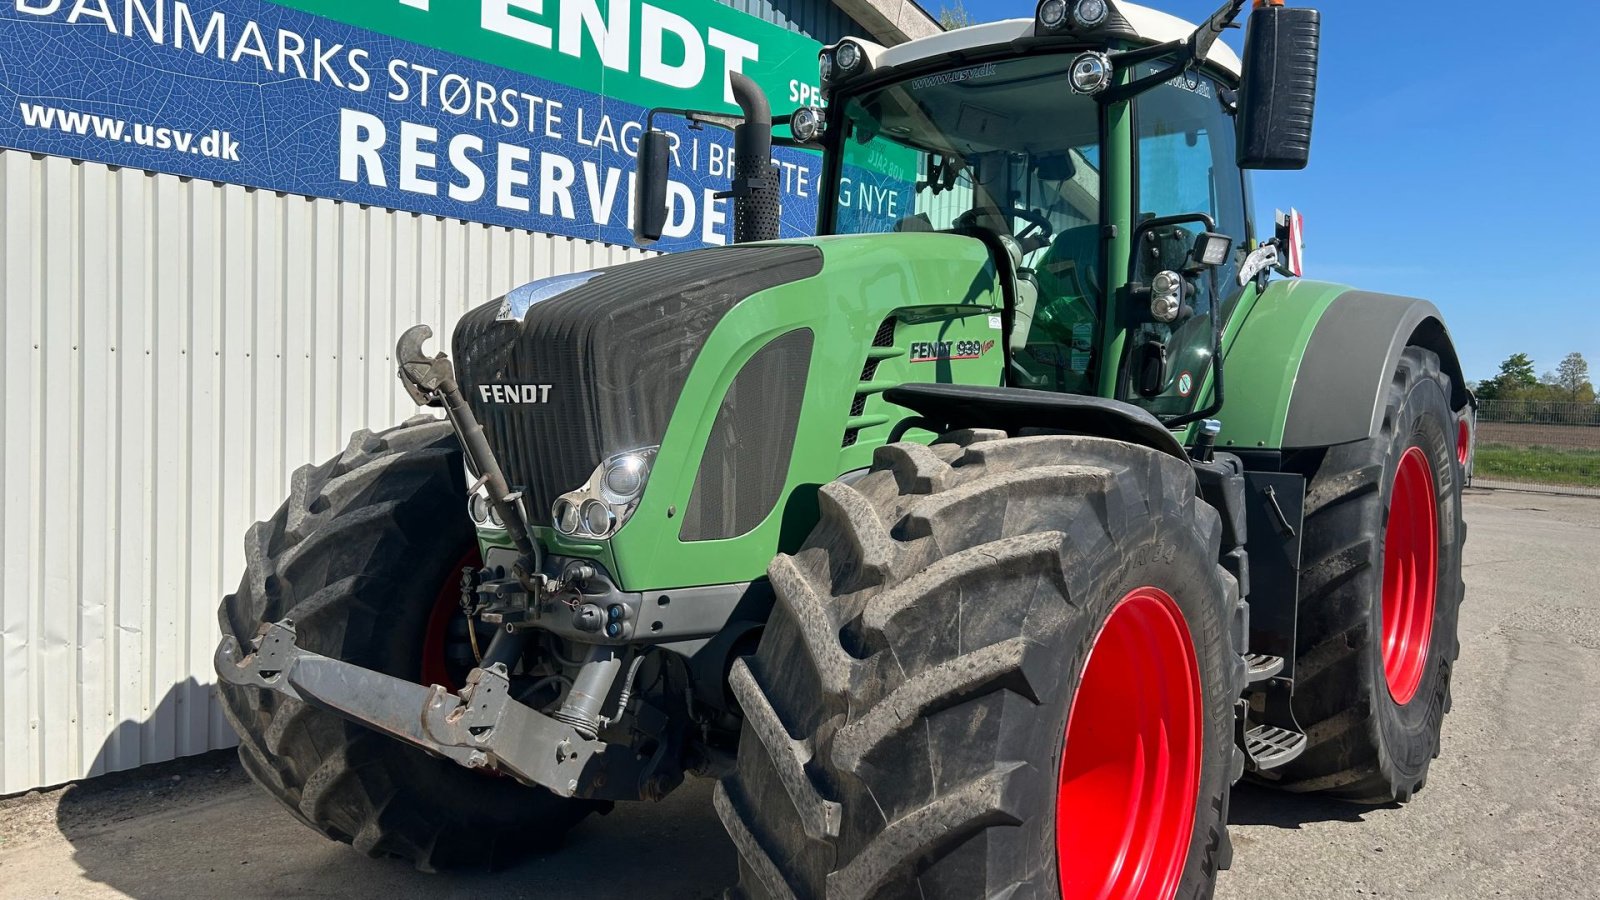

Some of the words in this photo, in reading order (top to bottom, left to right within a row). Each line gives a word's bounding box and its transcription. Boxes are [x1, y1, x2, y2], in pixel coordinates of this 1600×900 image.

[399, 0, 759, 104] NDT
[789, 79, 828, 109] SPE
[911, 63, 997, 90] www.usv.dk
[16, 0, 371, 93] ANMARKS
[388, 59, 563, 140] STØRSTE
[577, 107, 682, 168] LAGR
[692, 138, 697, 171] I
[709, 142, 810, 198] BTE
[816, 177, 851, 208] G
[858, 182, 898, 218] NYE
[19, 101, 241, 162] www.usv.dk
[337, 108, 783, 247] RESERVDE
[909, 341, 953, 359] FENDT
[956, 340, 981, 356] 939
[478, 384, 553, 404] FENDT
